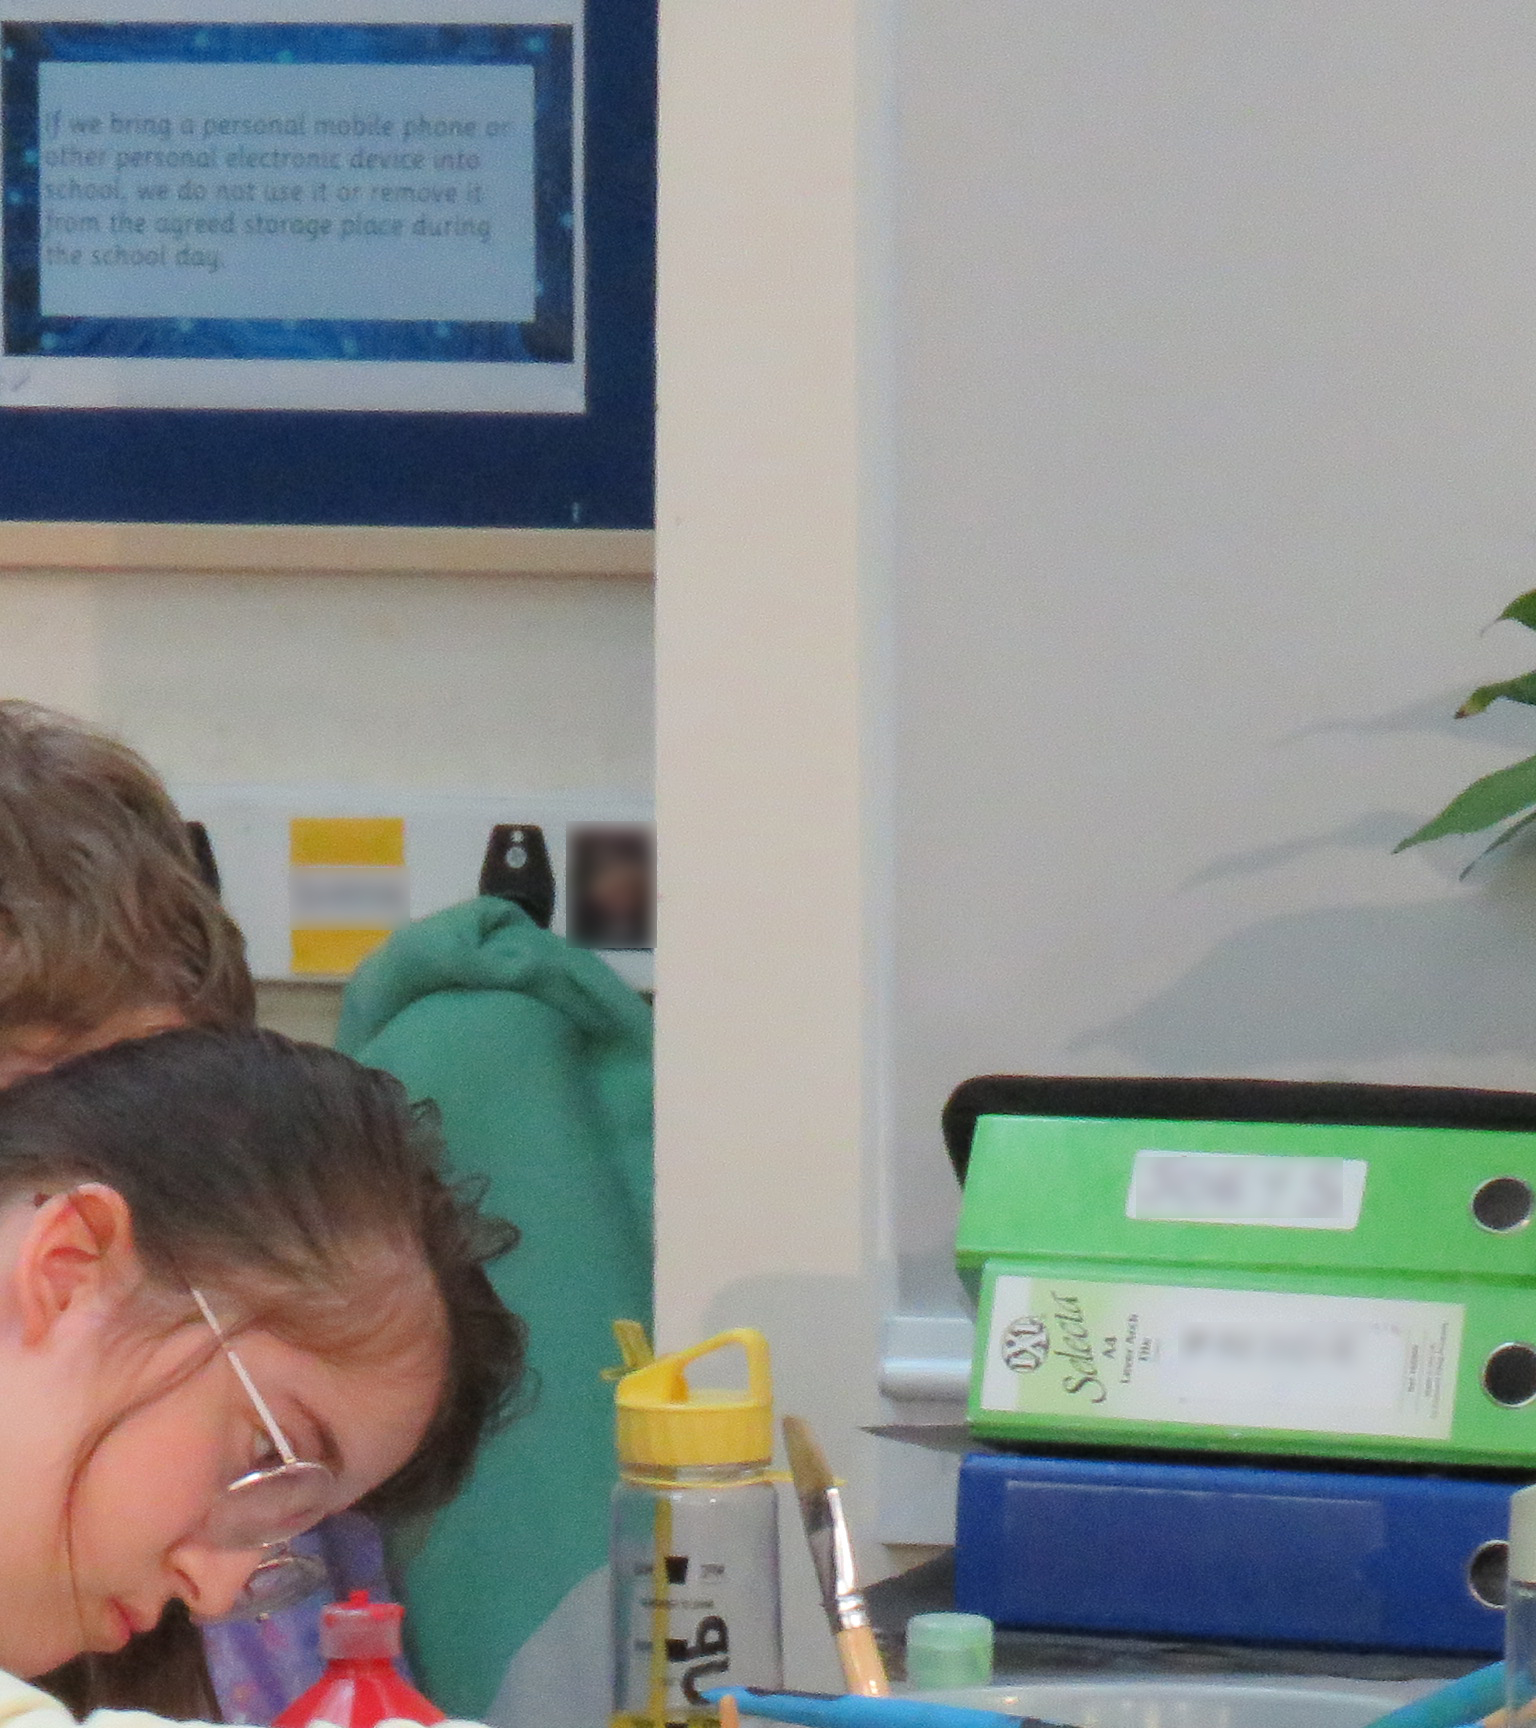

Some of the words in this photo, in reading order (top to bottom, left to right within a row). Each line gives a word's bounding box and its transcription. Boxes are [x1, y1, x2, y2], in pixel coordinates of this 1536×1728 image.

[45, 115, 61, 139] If
[70, 116, 102, 133] we
[111, 115, 171, 141] bring
[180, 119, 193, 134] a
[203, 115, 305, 141] personal
[314, 117, 394, 137] mobile
[403, 119, 476, 142] phone
[485, 121, 509, 138] or
[45, 148, 106, 167] other
[116, 148, 218, 173] personal
[225, 149, 340, 170] electronic
[349, 150, 425, 170] device
[433, 151, 481, 170] into
[136, 185, 169, 201] we
[178, 182, 206, 201] do
[216, 183, 256, 201] not
[264, 187, 302, 202] use
[312, 183, 327, 201] it
[336, 186, 362, 201] or
[371, 186, 458, 204] remove
[466, 183, 483, 202] it
[45, 215, 99, 236] from
[110, 214, 146, 233] the
[155, 215, 235, 239] agreed
[244, 217, 332, 241] storage
[341, 216, 403, 240] place
[412, 216, 491, 243] during
[46, 247, 82, 266] the
[91, 247, 166, 266] school
[1102, 1335, 1117, 1359] A4
